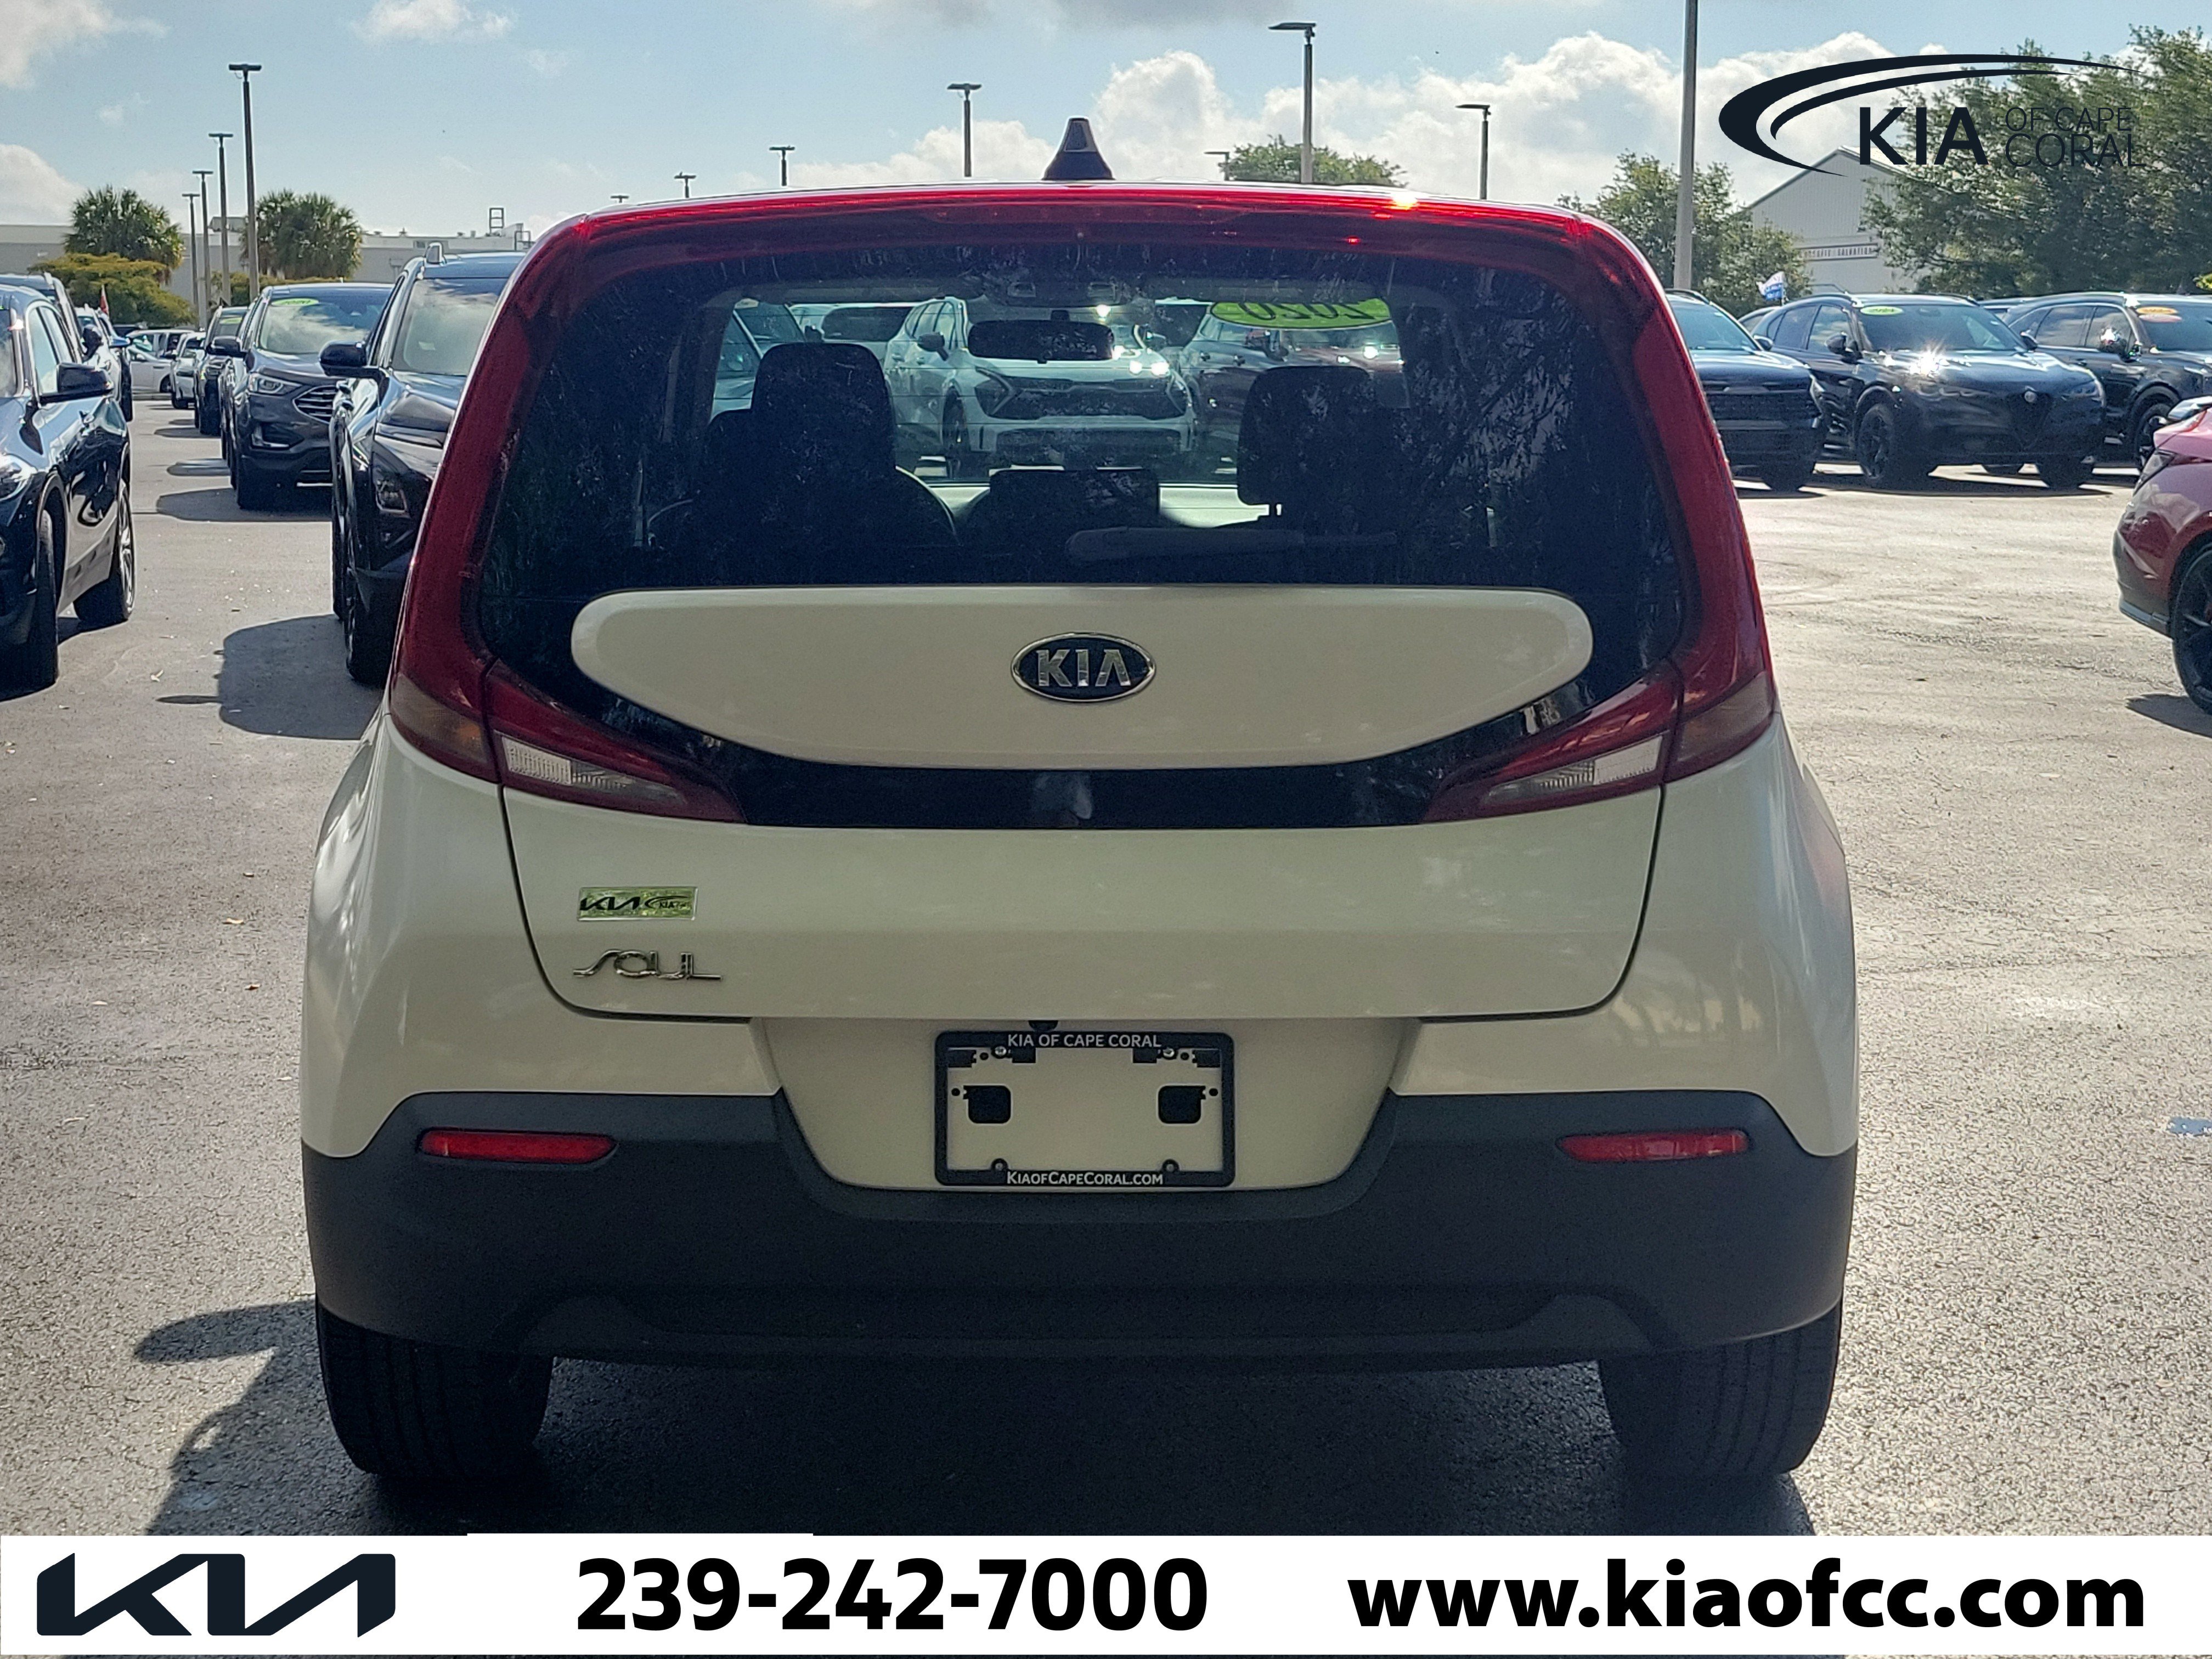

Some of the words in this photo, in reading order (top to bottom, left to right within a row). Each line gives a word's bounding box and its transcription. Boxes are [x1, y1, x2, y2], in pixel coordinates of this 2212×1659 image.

[1036, 649, 1131, 686] KIA
[573, 949, 721, 980] SOUL
[1007, 1034, 1034, 1047] KIA
[1038, 1034, 1059, 1047] OF
[1063, 1034, 1104, 1047] CAPE
[1108, 1034, 1161, 1047] CORAL
